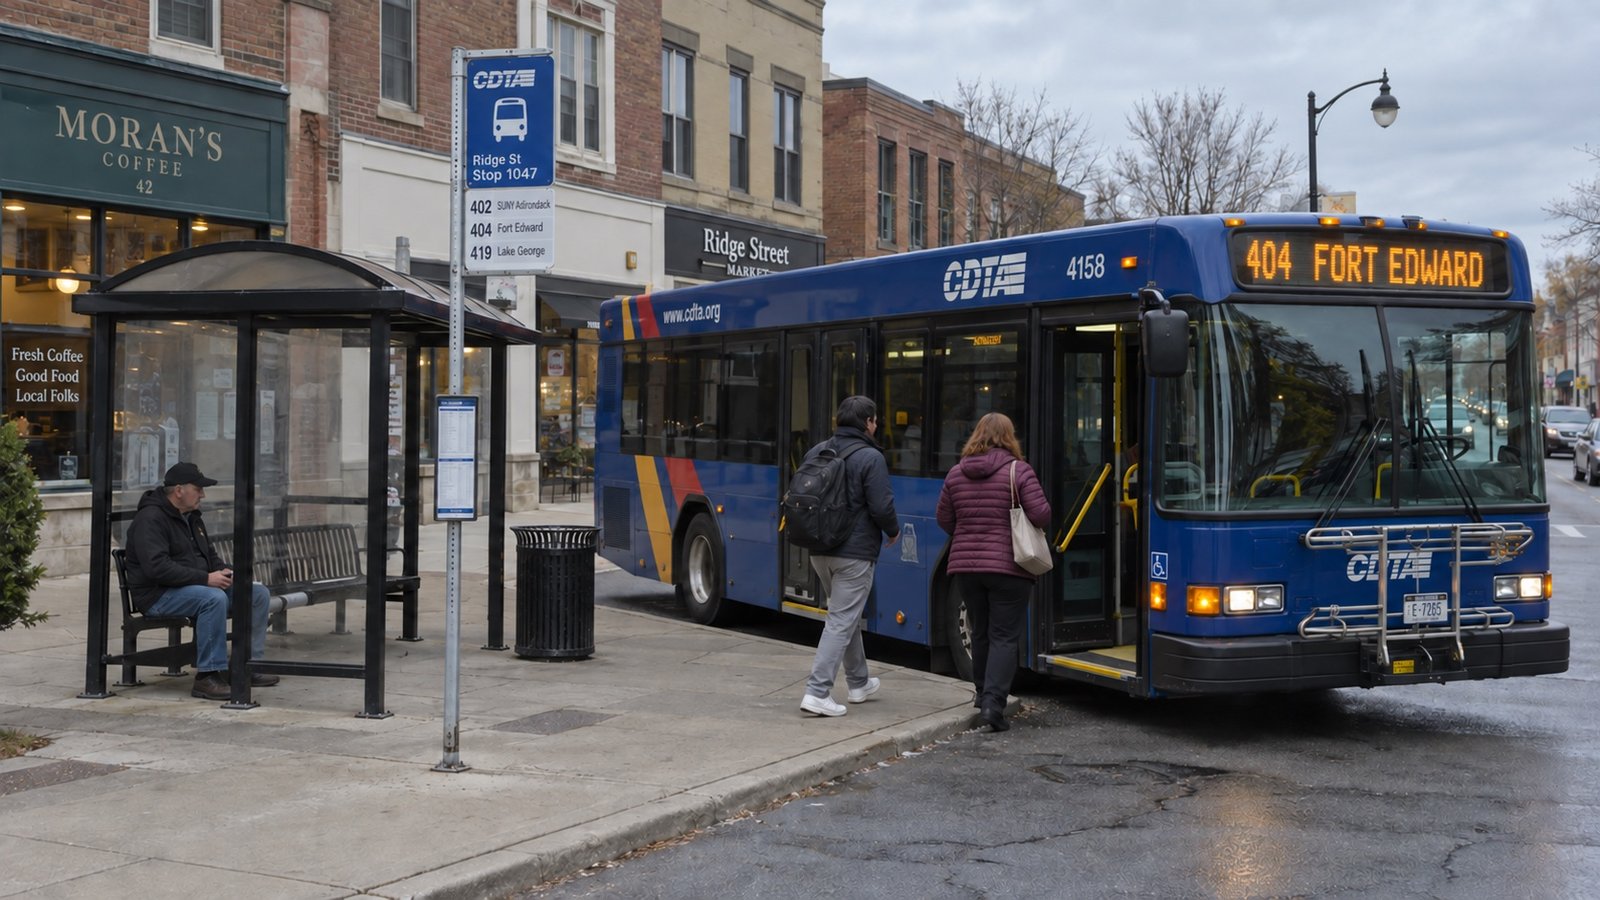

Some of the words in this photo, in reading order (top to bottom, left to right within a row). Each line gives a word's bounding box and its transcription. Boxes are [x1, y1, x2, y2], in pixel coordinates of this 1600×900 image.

[473, 69, 536, 90] CDTA
[55, 105, 223, 162] MORAN'S
[102, 151, 183, 177] COFFEE
[473, 154, 505, 168] Ridge
[509, 154, 522, 164] St
[473, 170, 502, 183] Stop
[506, 168, 538, 180] 1047
[136, 179, 153, 194] 42
[470, 200, 492, 214] 402
[497, 201, 514, 210] SUNY
[516, 200, 550, 210] Adirondack
[470, 223, 492, 238] 404
[498, 223, 513, 234] Fort
[516, 222, 544, 232] Edward
[470, 246, 492, 260] 419
[498, 246, 516, 256] Lake
[518, 246, 546, 258] George
[704, 228, 745, 262] Ridge
[750, 237, 789, 265] Street
[727, 264, 769, 278] MARKET
[1066, 253, 1105, 280] 4158
[1246, 240, 1292, 280] 404
[1314, 244, 1378, 283] FORT
[1389, 247, 1484, 288] EDWARD
[943, 252, 1027, 302] CDTA
[664, 302, 720, 324] www.cdta.org
[12, 347, 44, 362] Fresh
[47, 348, 84, 363] Coffee
[15, 368, 48, 382] Good
[51, 369, 79, 383] Food
[16, 388, 47, 402] Local
[50, 388, 80, 403] Folks
